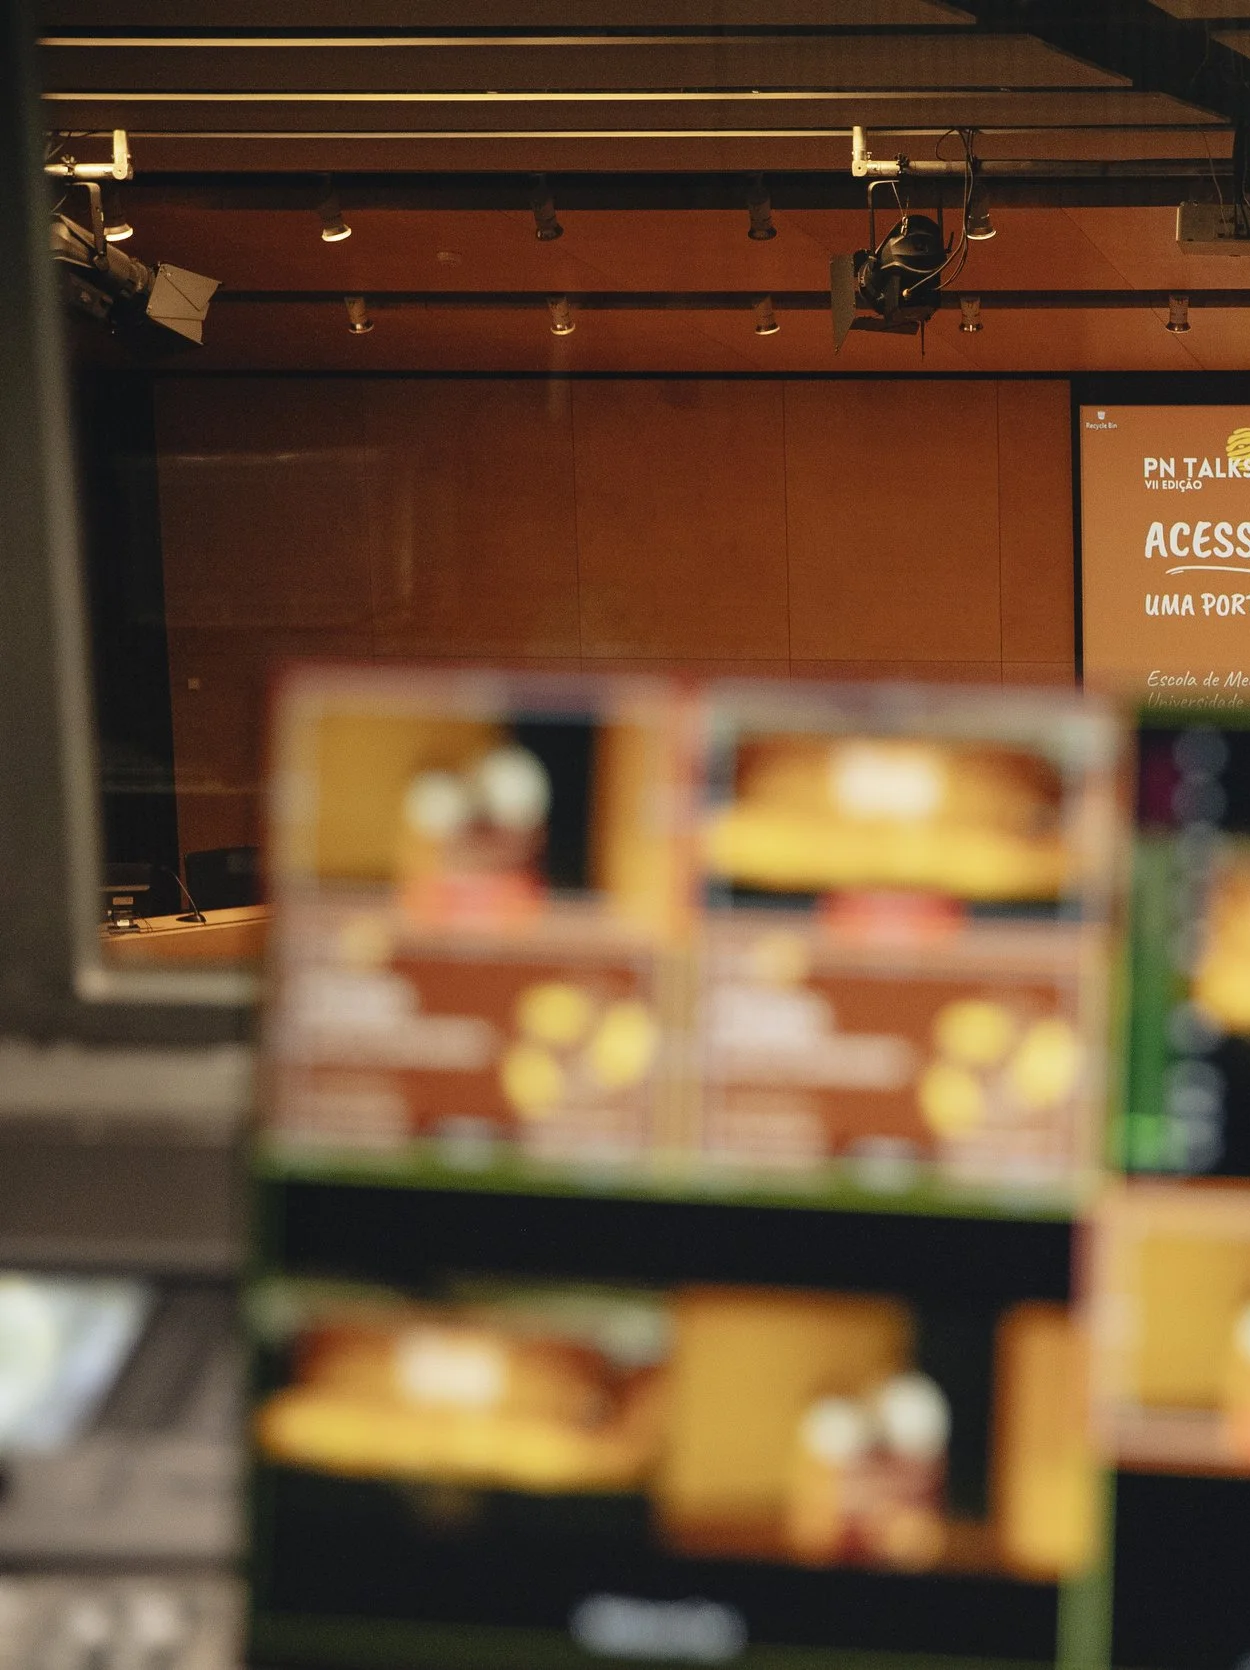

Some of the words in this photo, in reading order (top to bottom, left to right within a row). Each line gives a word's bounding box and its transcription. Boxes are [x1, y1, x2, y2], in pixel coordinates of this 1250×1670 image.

[1085, 422, 1107, 430] Recycle
[1143, 457, 1175, 478] PN
[1144, 480, 1159, 489] VII
[1162, 478, 1203, 492] EDIÇÃO
[1145, 594, 1195, 617] UMA
[1147, 670, 1198, 688] Escola
[1203, 671, 1220, 687] de
